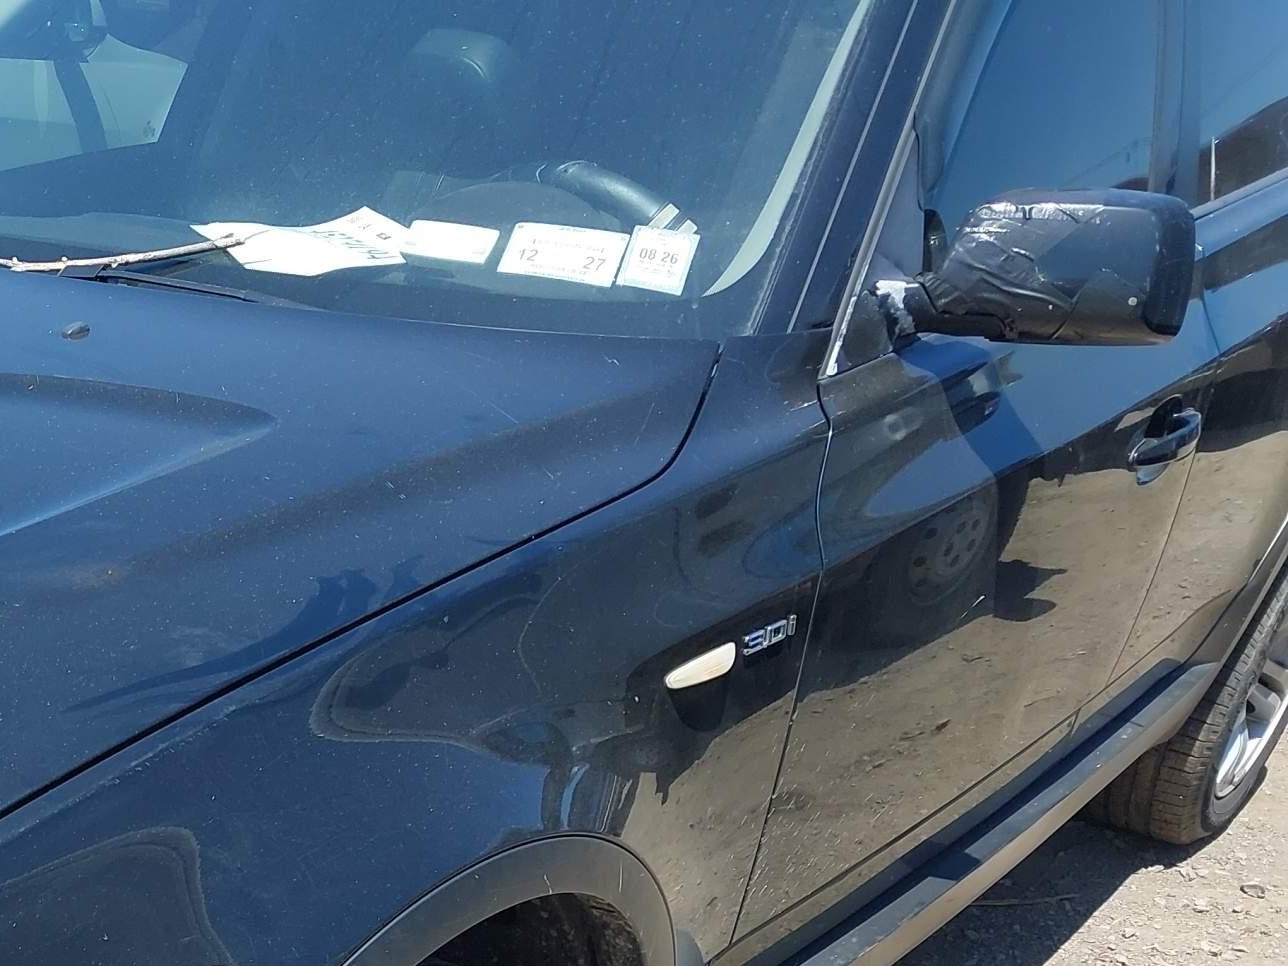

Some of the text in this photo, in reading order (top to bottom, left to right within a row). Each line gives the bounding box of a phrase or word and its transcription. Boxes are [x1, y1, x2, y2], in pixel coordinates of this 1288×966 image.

[520, 249, 538, 261] 12
[583, 256, 606, 272] 27
[639, 247, 679, 265] 08 26
